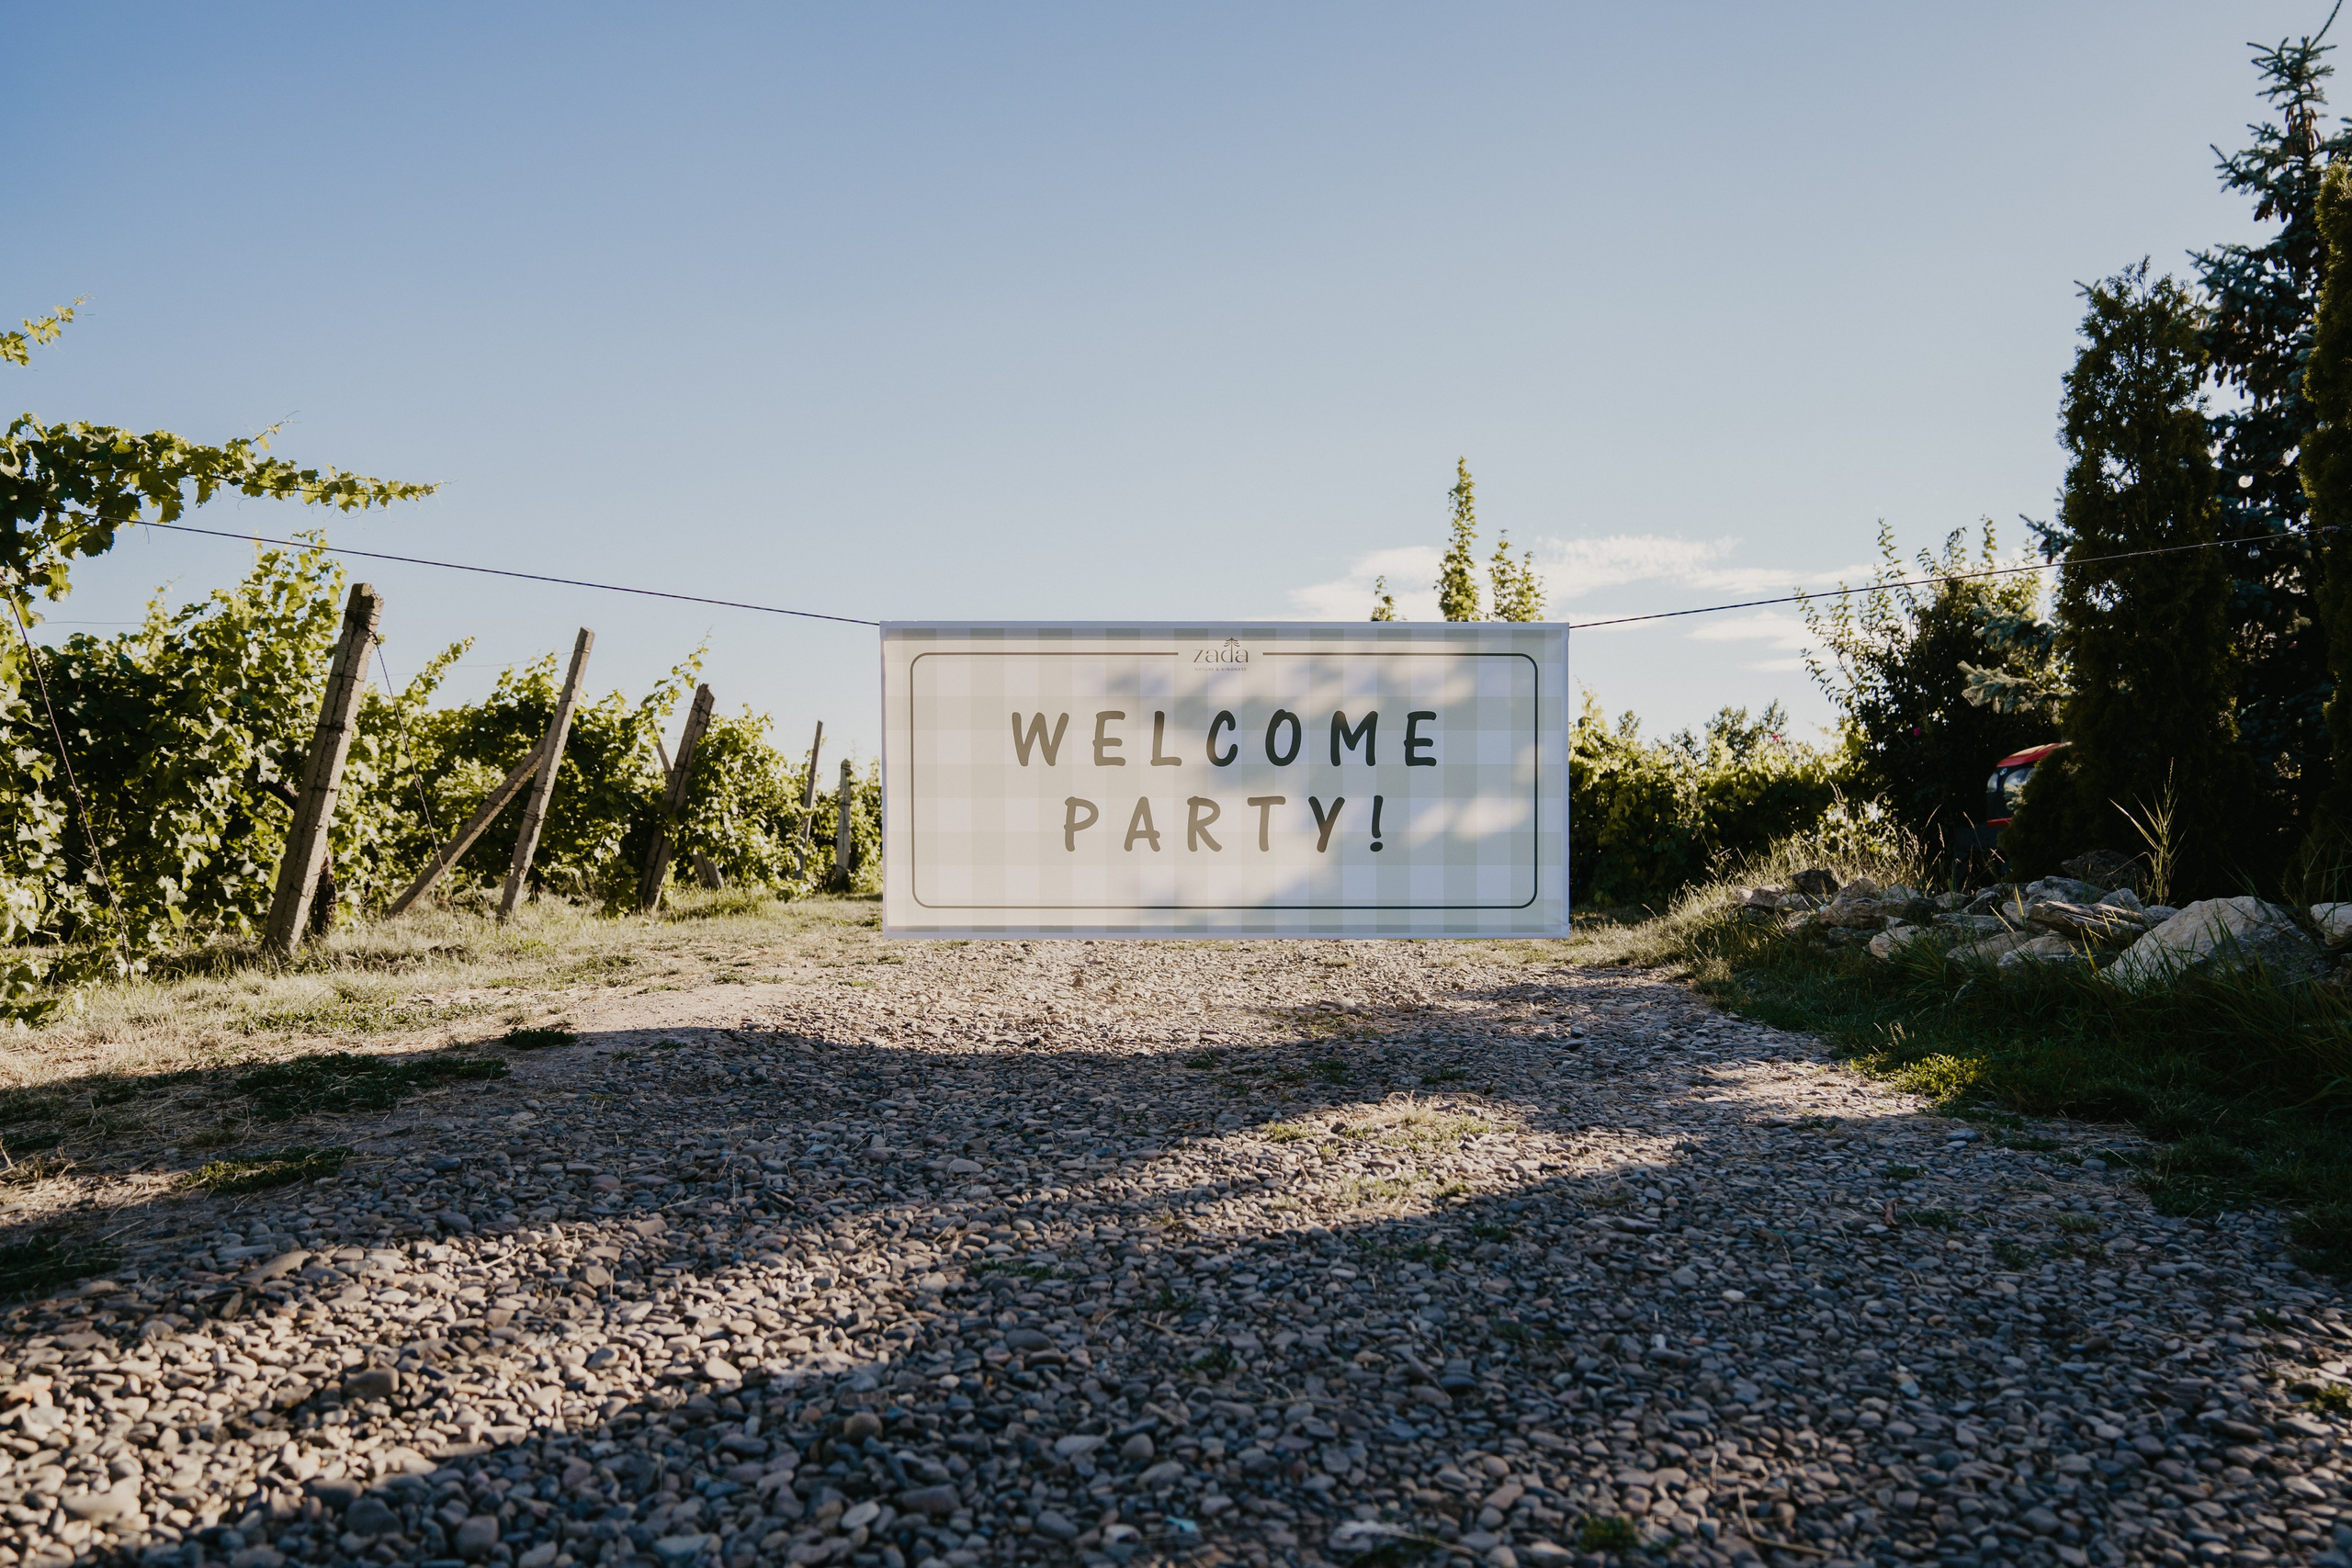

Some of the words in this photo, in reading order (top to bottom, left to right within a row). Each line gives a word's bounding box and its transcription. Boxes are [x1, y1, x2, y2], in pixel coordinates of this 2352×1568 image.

[1193, 637, 1249, 663] zada
[1012, 709, 1437, 767] WELCOME
[1063, 795, 1384, 852] PARTY!
